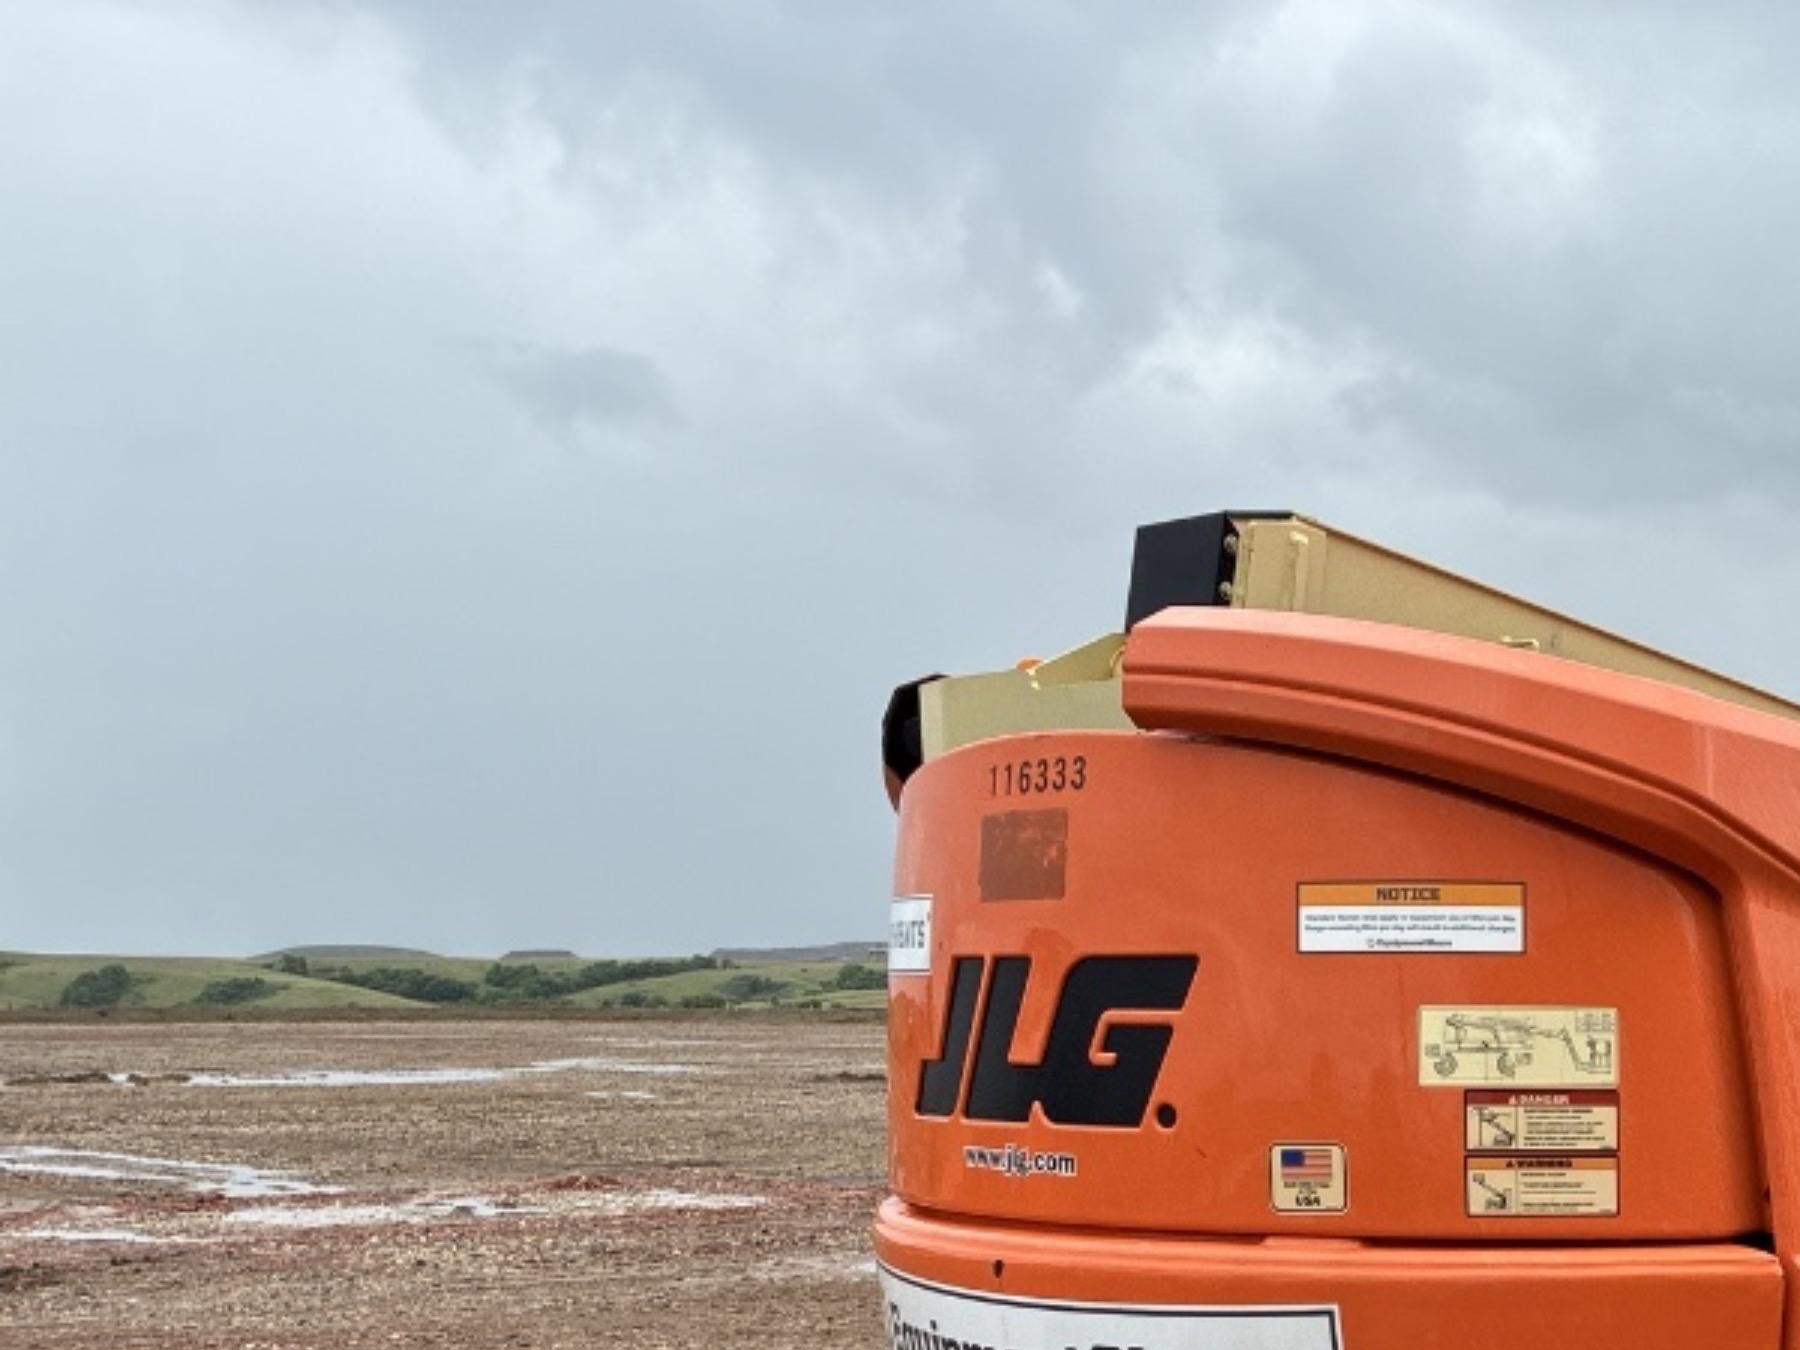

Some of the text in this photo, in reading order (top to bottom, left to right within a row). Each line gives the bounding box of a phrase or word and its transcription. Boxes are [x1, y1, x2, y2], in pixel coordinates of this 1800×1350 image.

[989, 755, 1087, 796] 116333
[1376, 887, 1441, 901] NOTICE
[915, 954, 1200, 1128] JLG
[964, 1144, 1078, 1176] www.jlg.com
